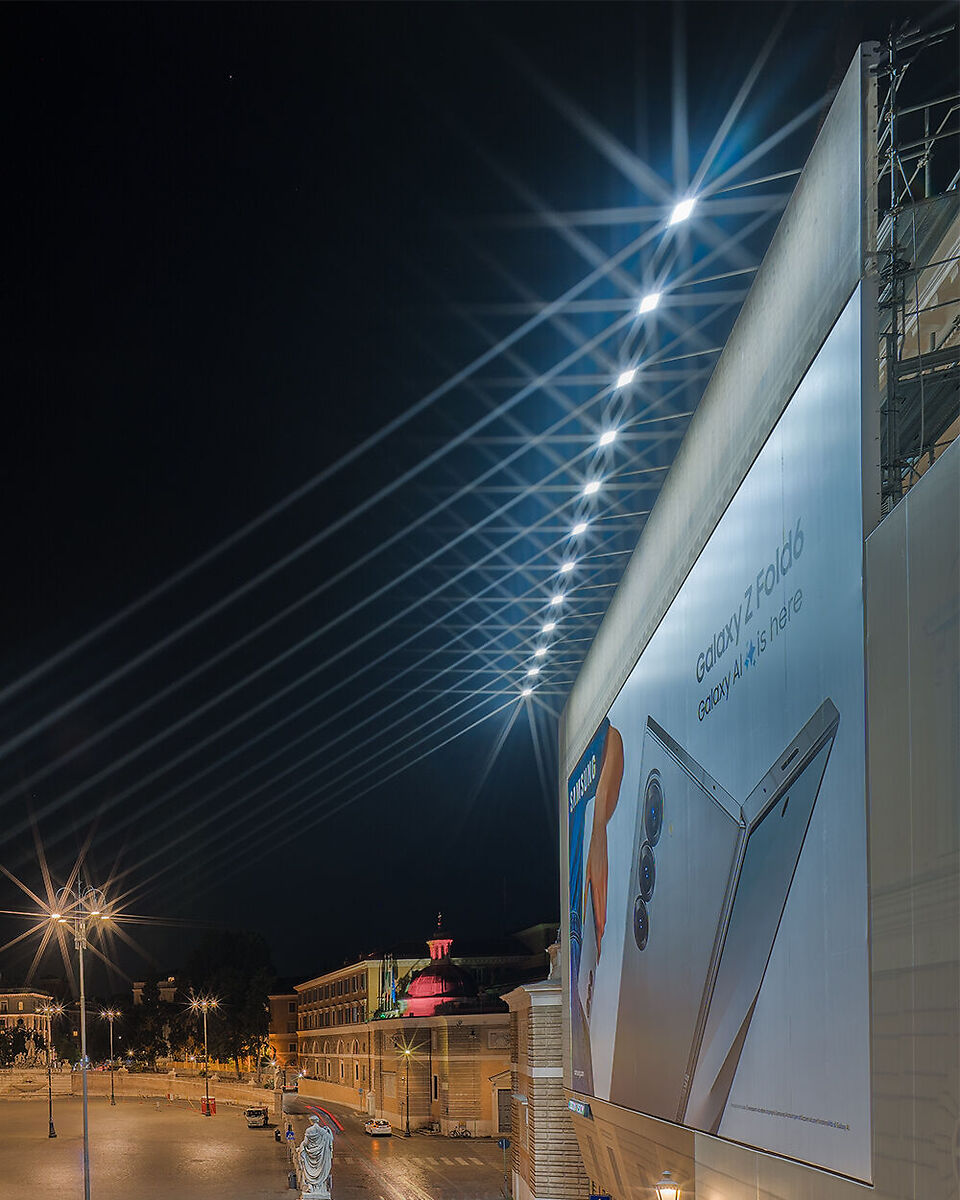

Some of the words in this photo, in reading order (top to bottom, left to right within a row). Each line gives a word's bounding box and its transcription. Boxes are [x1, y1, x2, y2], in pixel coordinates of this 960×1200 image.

[696, 604, 743, 684] Galaxy
[744, 584, 754, 626] Z
[756, 517, 805, 609] Fold6
[697, 672, 732, 722] Galaxy
[732, 653, 743, 685] AI
[757, 630, 767, 656] is
[770, 588, 803, 642] here
[569, 754, 597, 813] SAMSUNG
